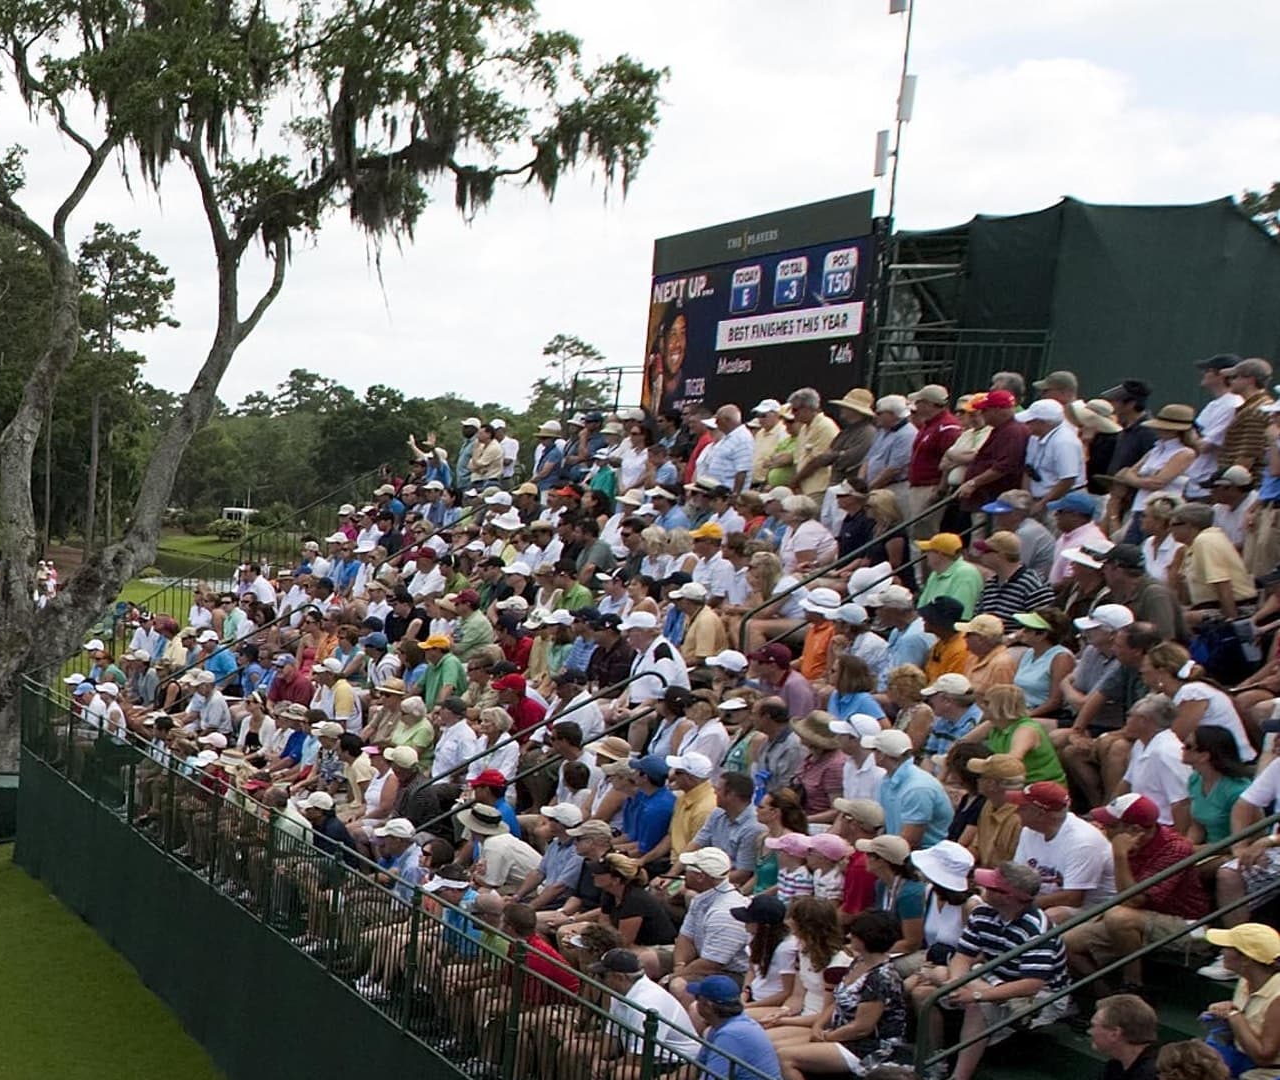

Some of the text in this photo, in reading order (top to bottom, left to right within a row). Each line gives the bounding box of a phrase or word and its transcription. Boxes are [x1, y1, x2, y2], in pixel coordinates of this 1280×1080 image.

[747, 229, 779, 246] PLAYERS
[780, 262, 803, 276] TOTAL
[832, 253, 849, 268] POS
[653, 278, 687, 304] NEXT
[784, 280, 797, 300] -3
[827, 272, 851, 294] T50
[728, 313, 848, 342] BEST FINISHES THIS YEAR
[716, 357, 752, 375] Masters
